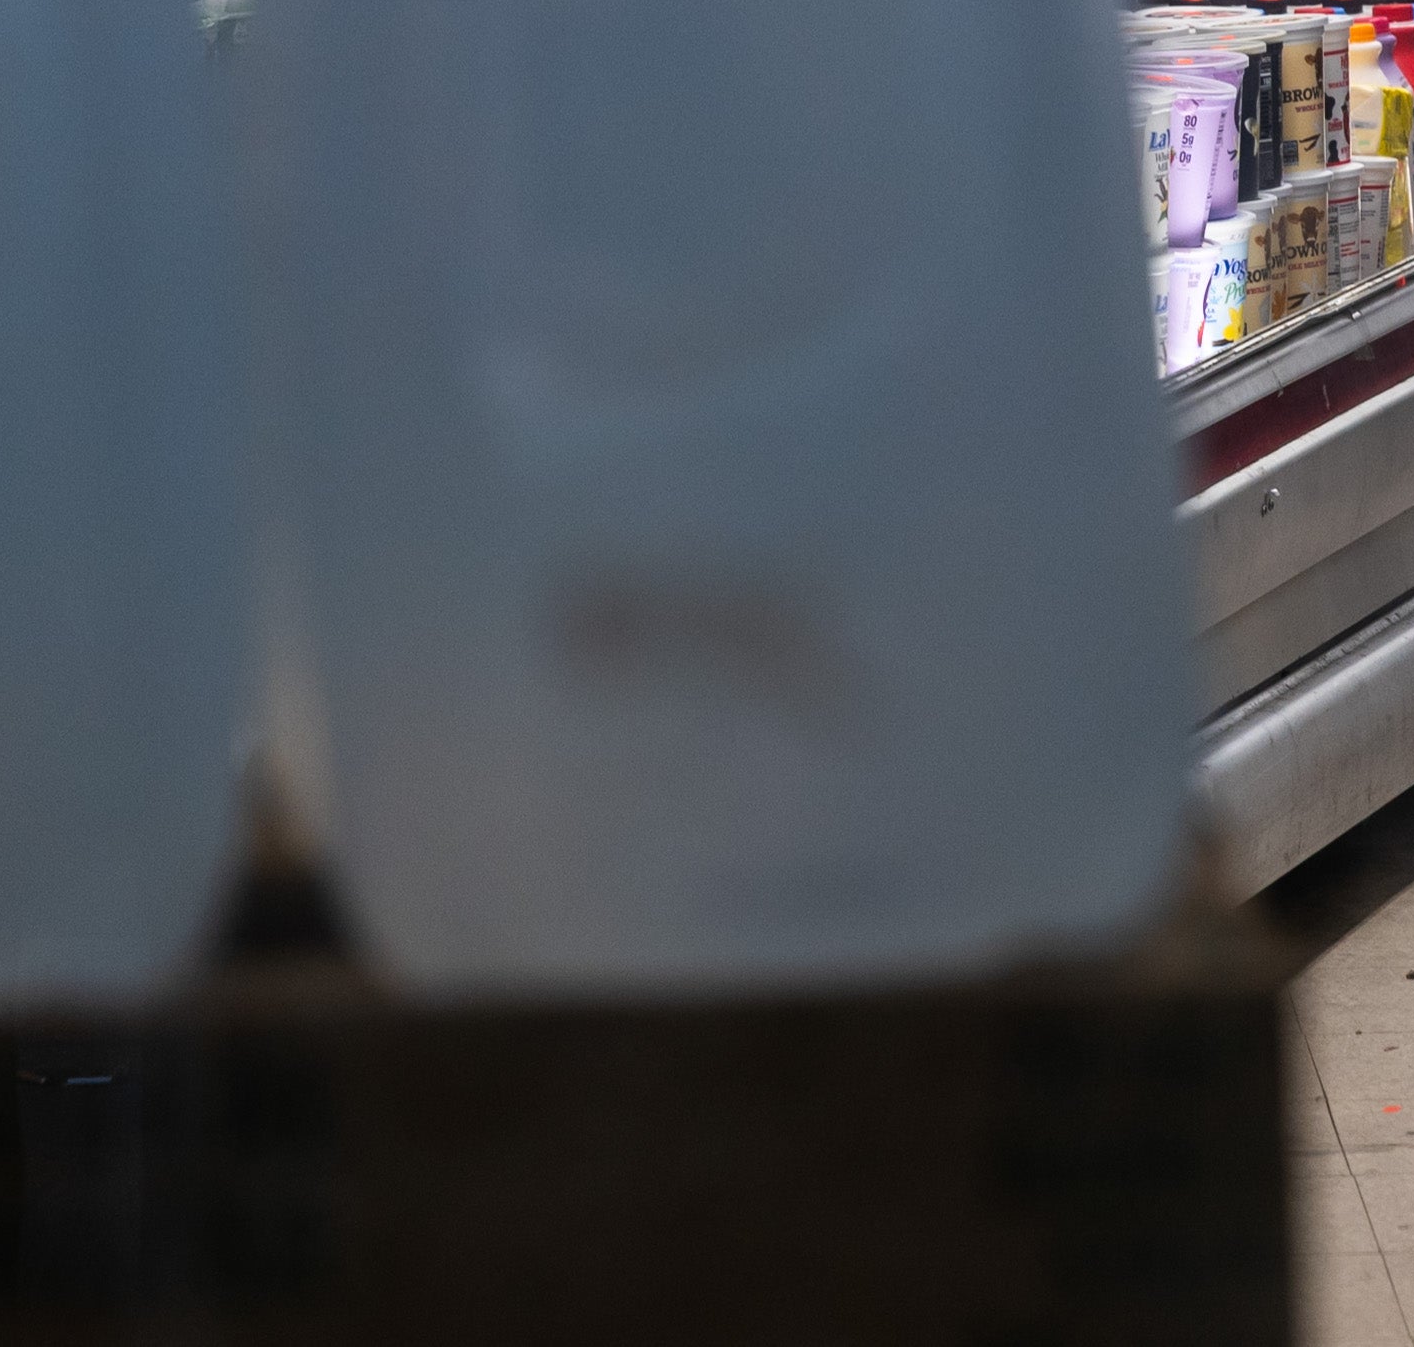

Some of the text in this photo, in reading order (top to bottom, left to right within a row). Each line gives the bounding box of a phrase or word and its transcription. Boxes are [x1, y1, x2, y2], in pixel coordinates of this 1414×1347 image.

[1183, 114, 1198, 128] 80
[1181, 132, 1195, 146] 5g
[1179, 150, 1192, 164] 0g
